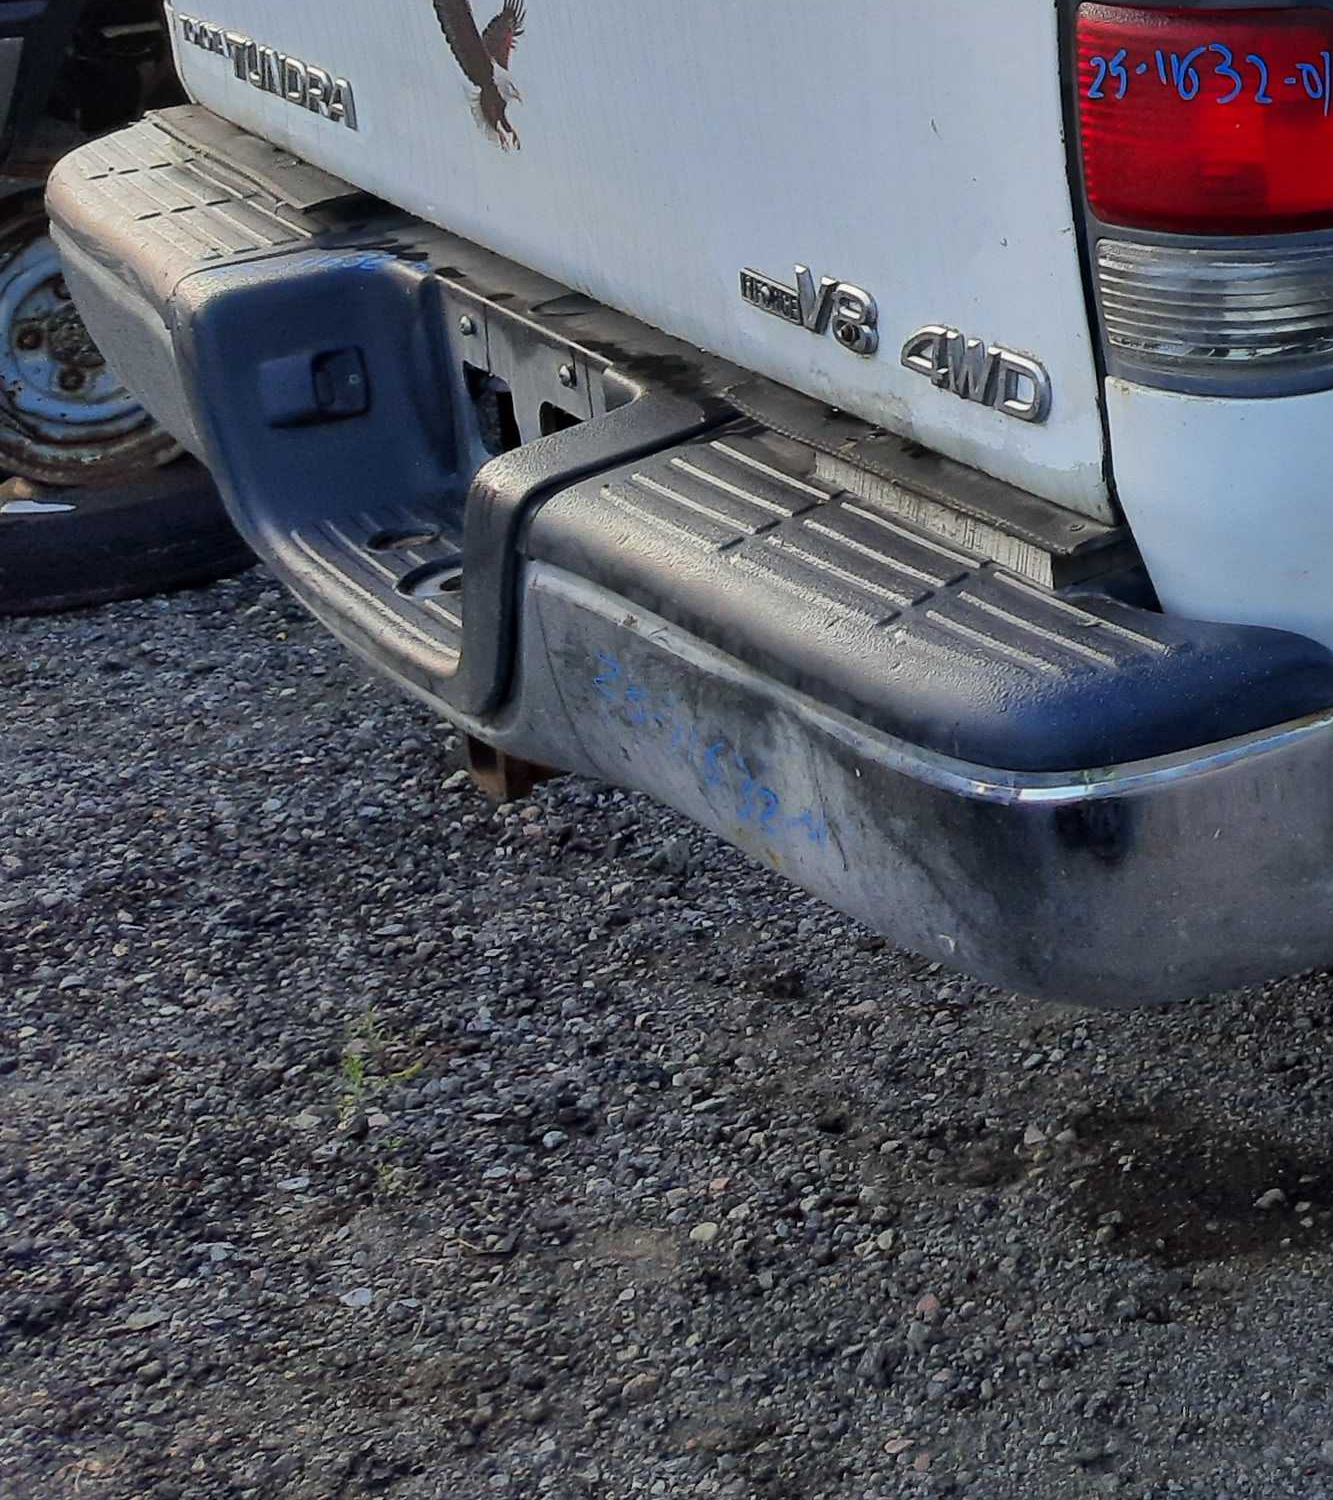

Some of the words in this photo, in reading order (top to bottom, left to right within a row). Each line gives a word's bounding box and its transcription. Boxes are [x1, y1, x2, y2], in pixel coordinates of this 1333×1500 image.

[225, 29, 360, 133] TUNDRA
[1087, 42, 1331, 117] 25-11632-01
[795, 262, 880, 356] V8
[900, 322, 1053, 423] 4WD
